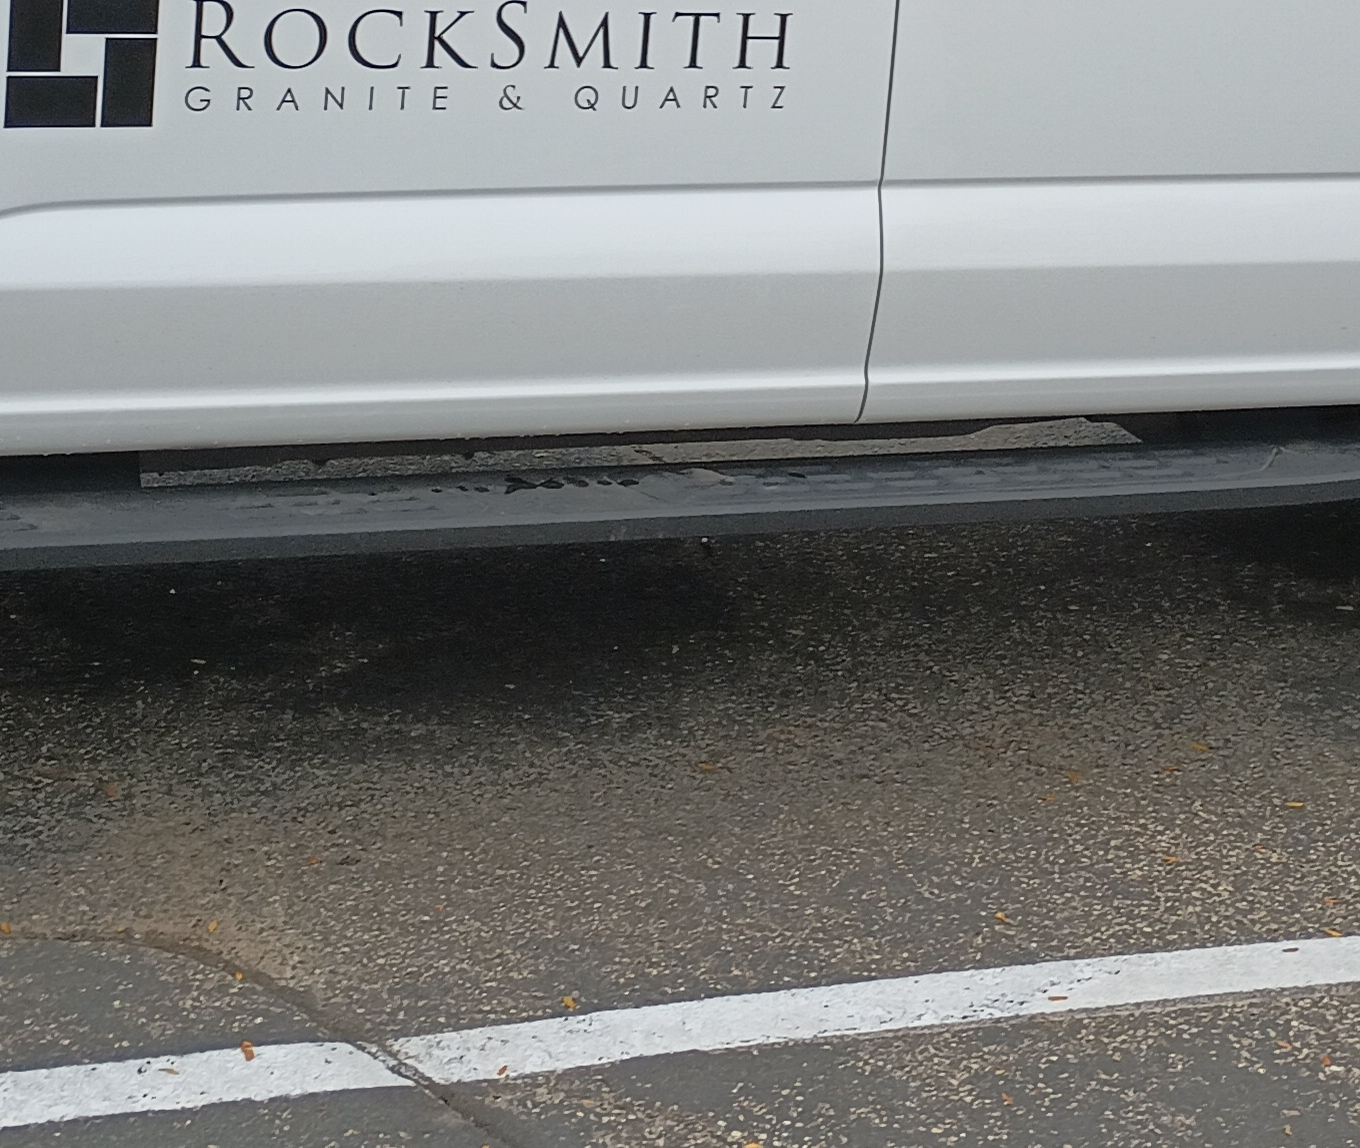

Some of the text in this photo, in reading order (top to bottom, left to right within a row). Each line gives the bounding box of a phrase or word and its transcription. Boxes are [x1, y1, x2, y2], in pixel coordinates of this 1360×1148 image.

[185, 84, 788, 112] GRANITE & QUARTZ
